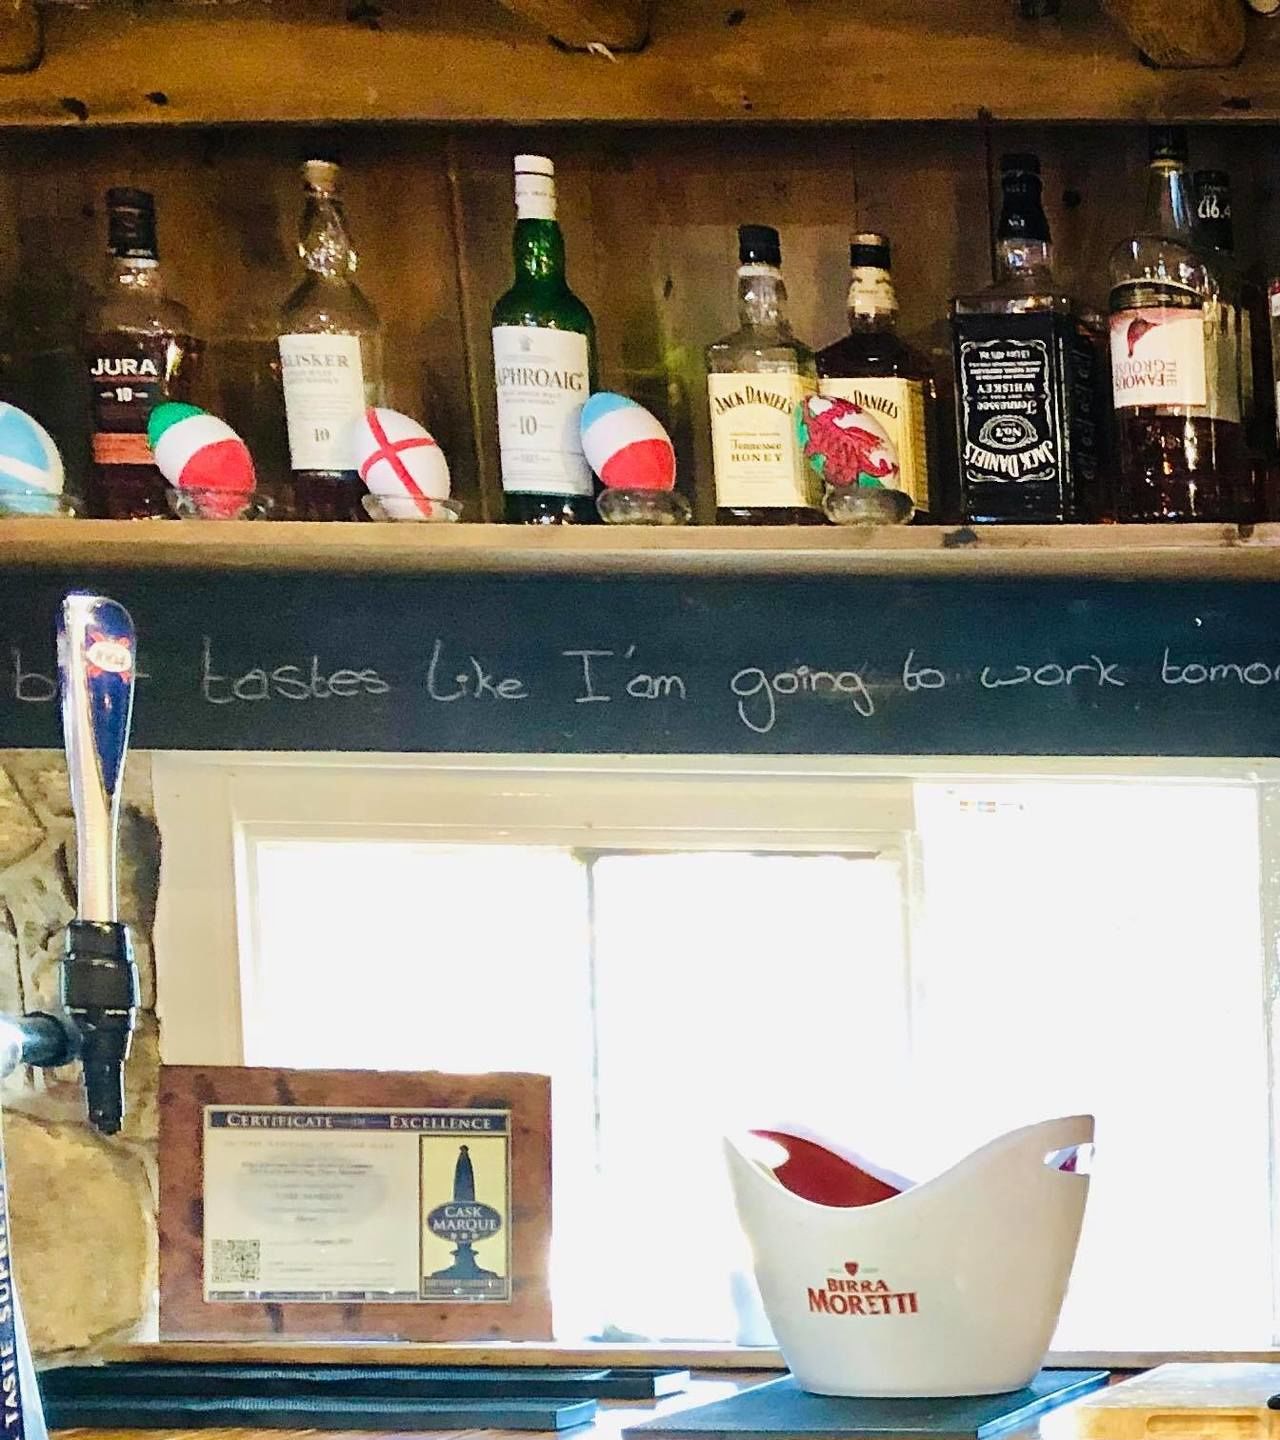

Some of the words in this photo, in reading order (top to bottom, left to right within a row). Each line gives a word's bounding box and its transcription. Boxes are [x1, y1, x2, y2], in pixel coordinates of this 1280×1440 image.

[91, 358, 158, 377] JURA
[115, 387, 133, 402] 10
[977, 383, 1035, 393] WHISKEY
[716, 391, 744, 415] JACK
[519, 415, 538, 435] 10
[731, 439, 782, 450] Tennessee
[731, 454, 783, 462] HONEY
[1019, 440, 1055, 471] JACK
[201, 636, 389, 704] tastes
[731, 662, 875, 733] going
[903, 648, 946, 690] to
[981, 655, 1125, 689] work
[227, 1113, 333, 1128] CERTIFICATE
[389, 1116, 491, 1129] EXCELLENCE
[444, 1206, 481, 1218] CASK
[432, 1218, 497, 1231] MARQUE
[826, 1278, 889, 1293] BIRRA
[807, 1288, 918, 1315] MORETTI
[0, 1341, 20, 1424] TASTE
